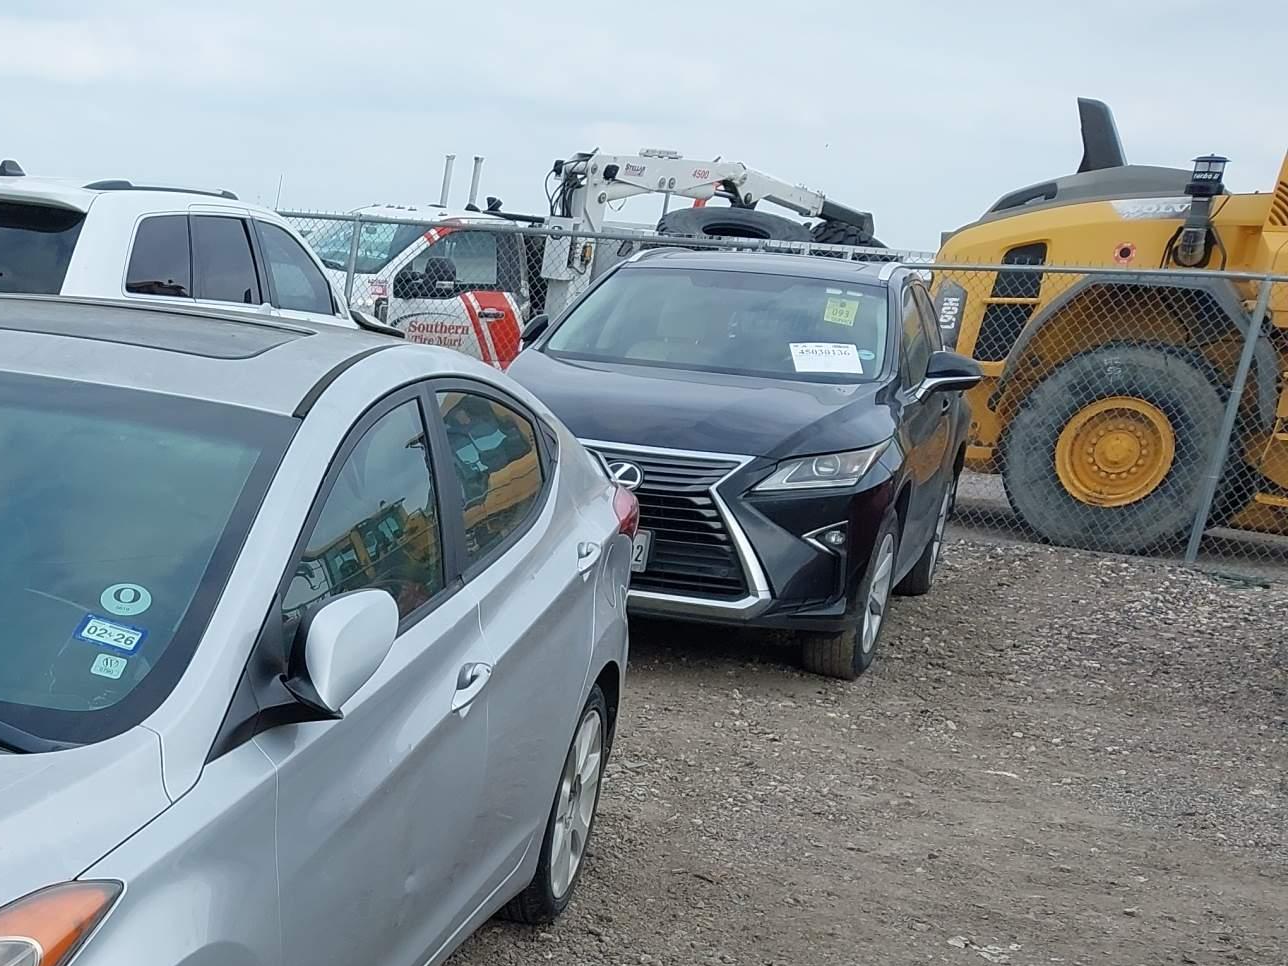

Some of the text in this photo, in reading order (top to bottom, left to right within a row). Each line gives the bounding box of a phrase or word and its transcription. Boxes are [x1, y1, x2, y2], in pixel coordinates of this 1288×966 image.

[408, 321, 469, 335] Southern
[411, 335, 463, 347] Tire Mart
